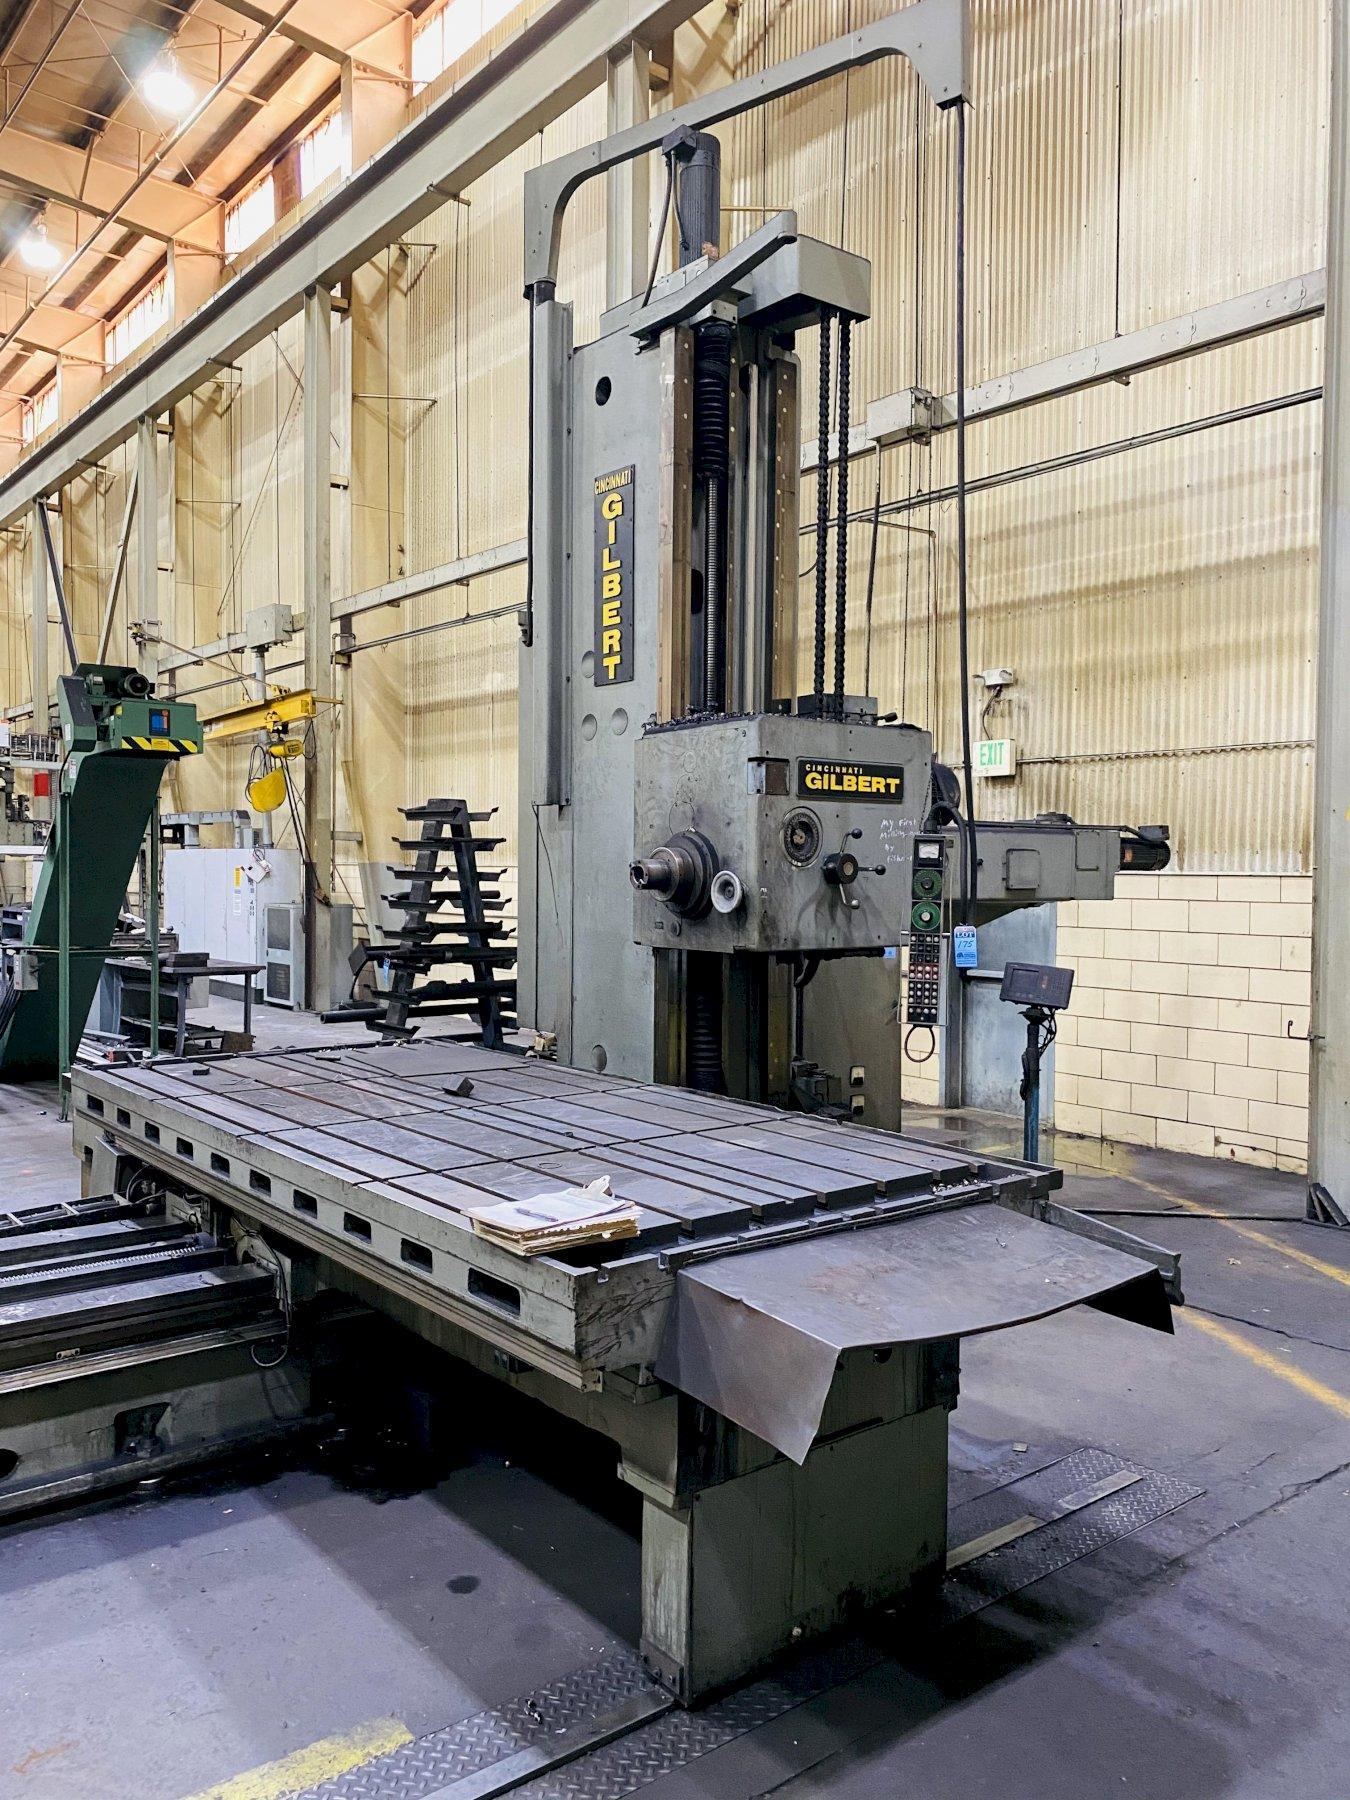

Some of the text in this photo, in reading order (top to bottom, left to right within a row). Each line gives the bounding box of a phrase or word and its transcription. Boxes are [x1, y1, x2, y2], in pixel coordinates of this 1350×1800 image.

[594, 469, 632, 495] CINCINNATI
[601, 492, 624, 681] GILBERT
[980, 742, 1004, 766] EXIT
[805, 764, 863, 775] CINCINNATI
[804, 772, 900, 794] GILBERT
[957, 940, 974, 949] 175
